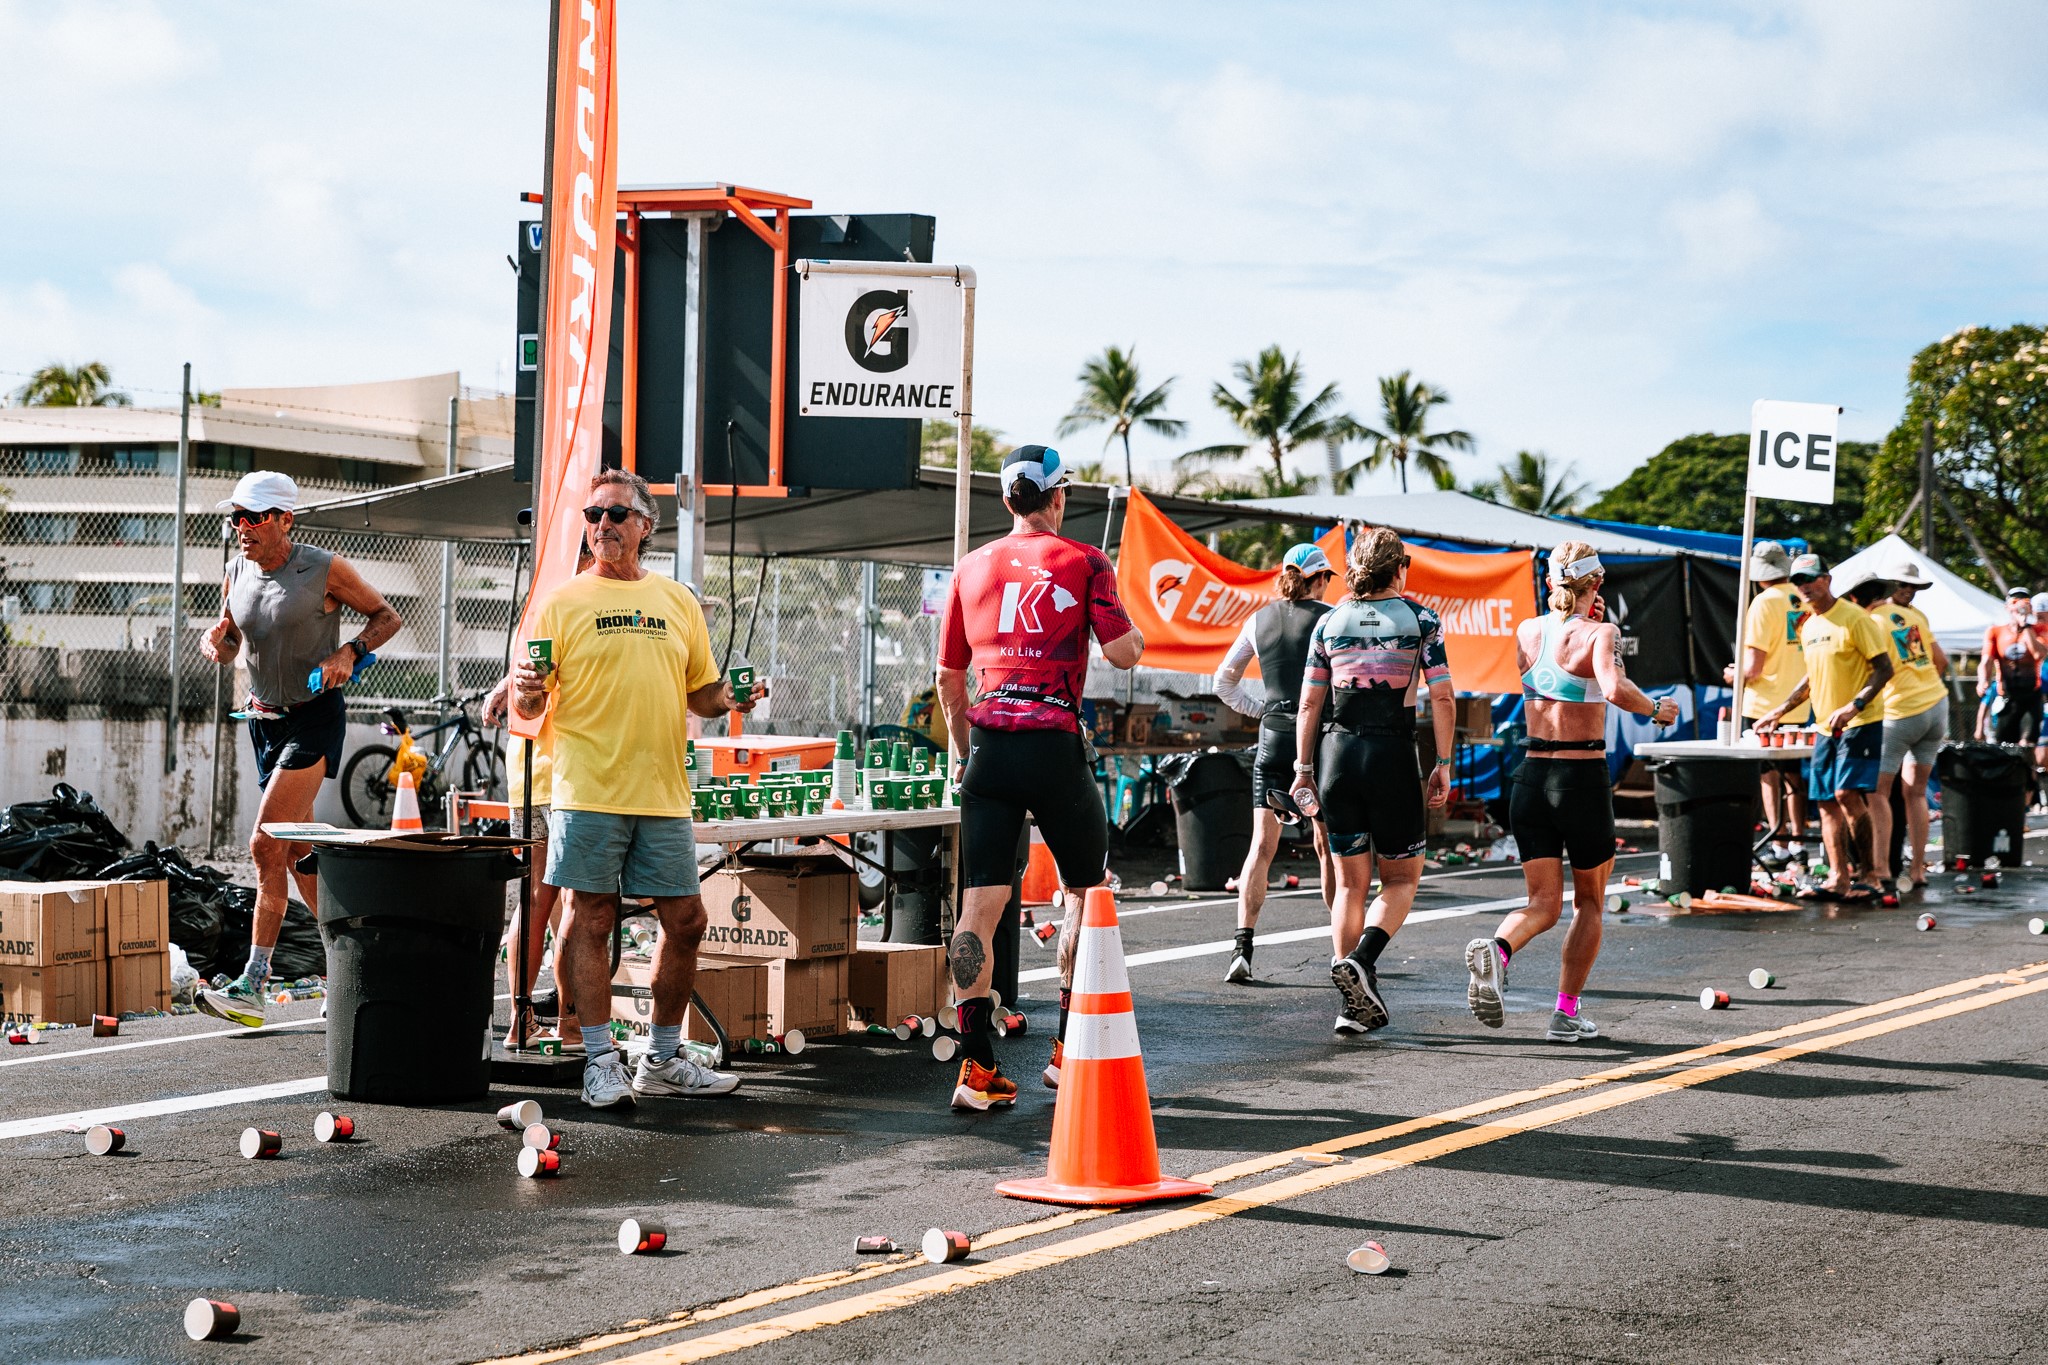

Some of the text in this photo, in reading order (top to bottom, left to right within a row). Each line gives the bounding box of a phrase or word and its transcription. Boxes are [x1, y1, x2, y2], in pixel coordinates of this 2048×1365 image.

[845, 290, 908, 373] G
[810, 382, 954, 408] ENDURANCE
[1758, 430, 1832, 472] ICE
[597, 627, 668, 637] WORLD CHAMPIONSHIP
[1018, 648, 1042, 658] Like
[1019, 685, 1038, 693] sports
[984, 691, 1008, 699] 2XU
[1043, 696, 1070, 707] 2XU
[122, 940, 157, 951] GATORADE
[811, 943, 846, 953] GATORADE
[56, 950, 92, 961] GATORADE
